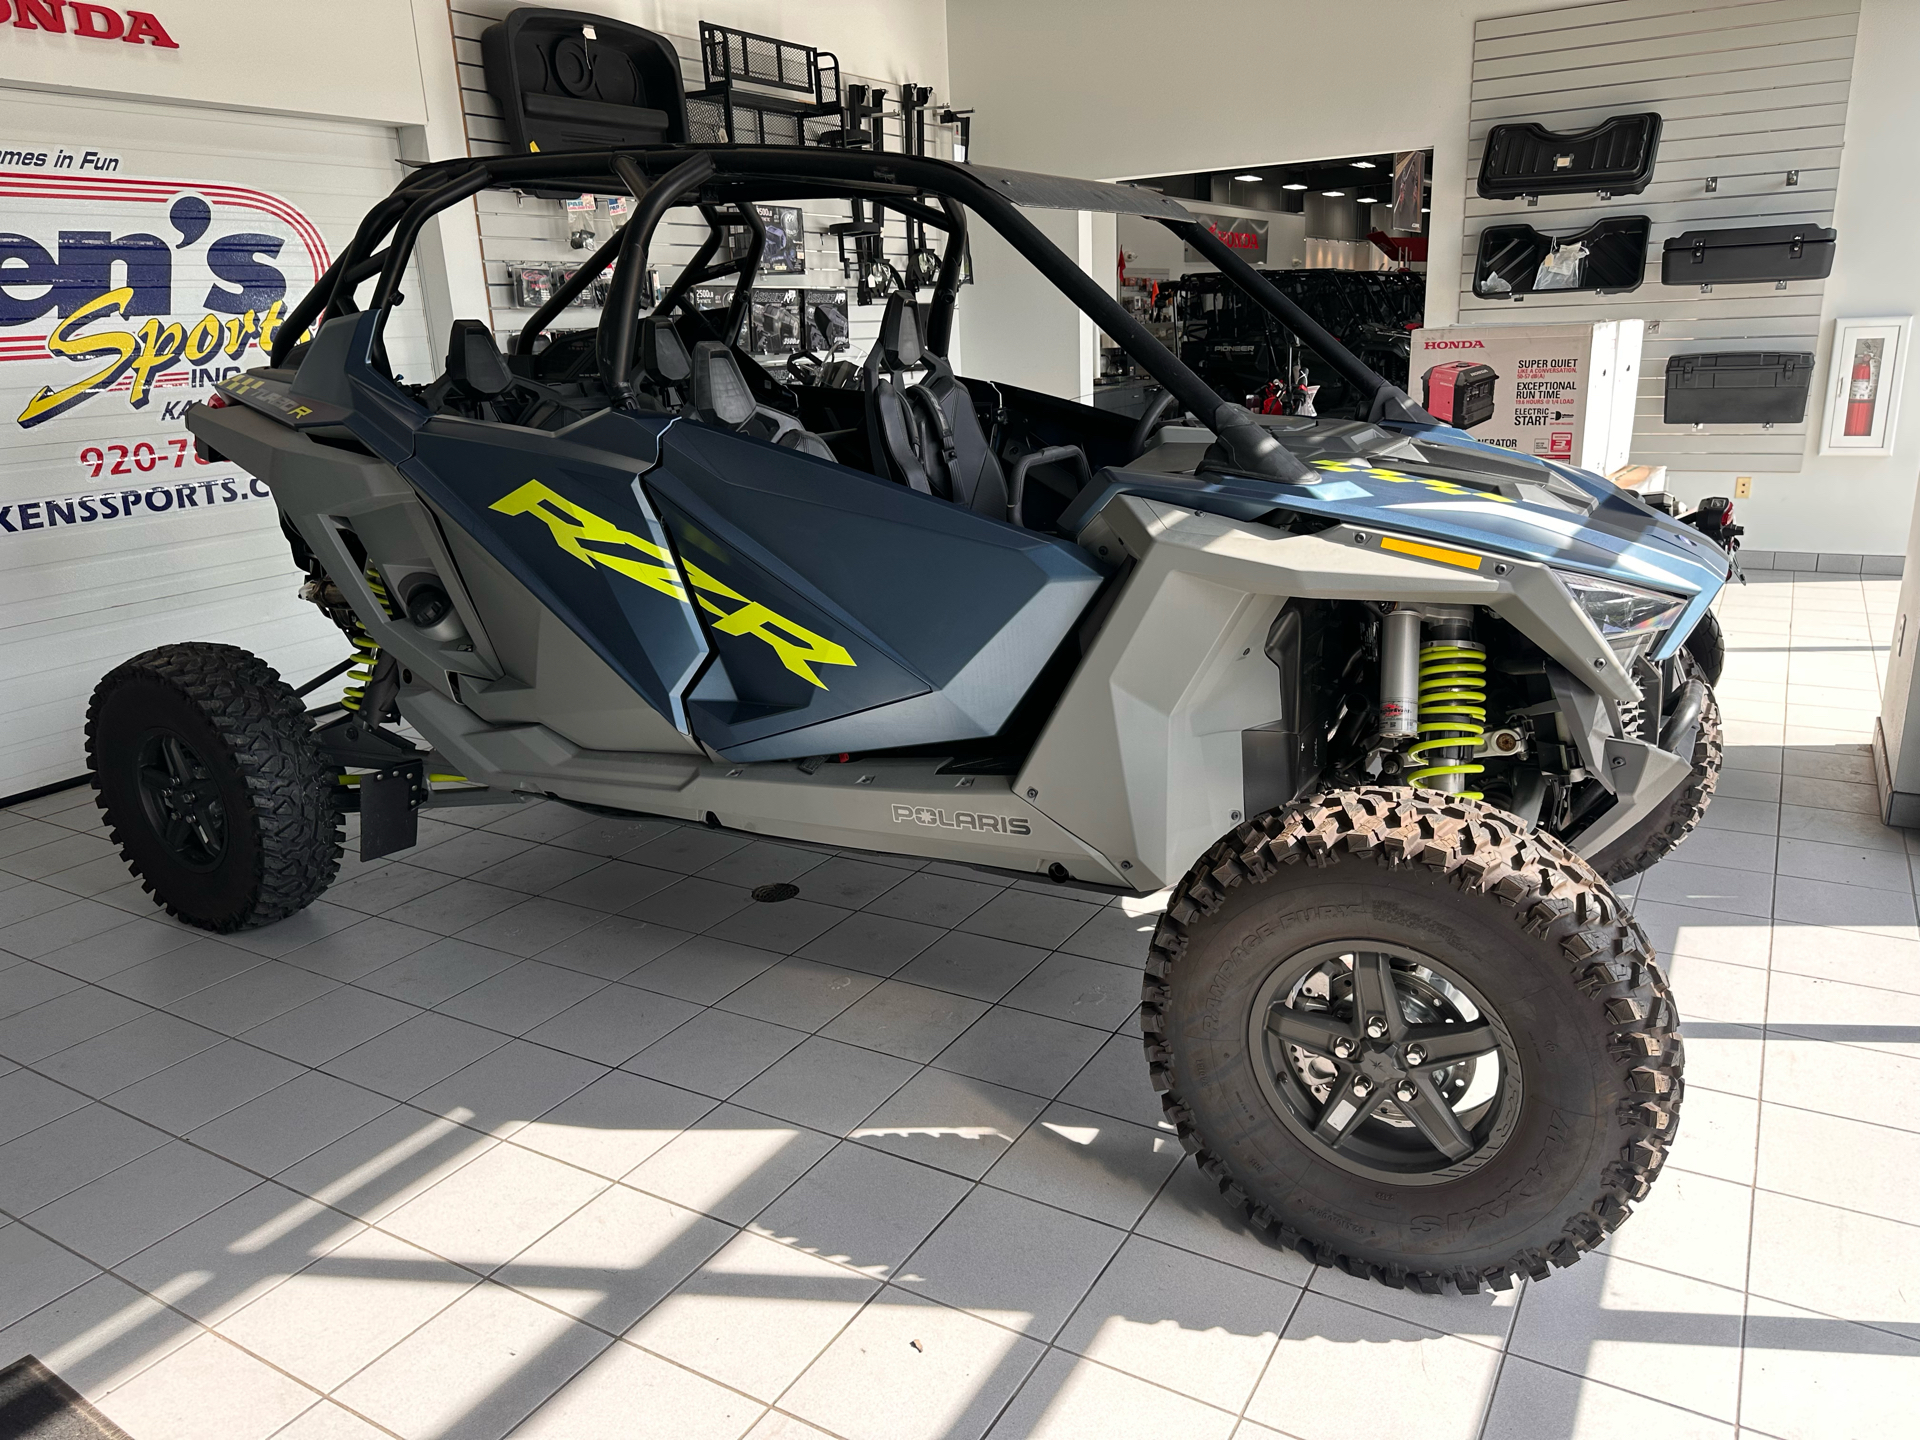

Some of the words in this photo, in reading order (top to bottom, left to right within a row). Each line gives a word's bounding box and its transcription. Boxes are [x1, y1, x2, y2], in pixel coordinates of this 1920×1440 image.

[0, 0, 180, 49] NDA
[0, 150, 48, 168] mes
[53, 149, 74, 170] in
[80, 151, 119, 172] Fun
[1217, 230, 1259, 250] HONDA
[17, 286, 312, 430] Sport
[1424, 340, 1485, 350] HONDA
[1518, 360, 1548, 368] SUPER
[1550, 358, 1578, 368] QUIET
[1516, 382, 1577, 390] EXCEPTIONAL
[1516, 390, 1536, 399] RUN
[1538, 390, 1560, 399] TIME
[250, 388, 300, 412] TURBO
[287, 406, 314, 420] R
[1514, 408, 1550, 416] ELECTRIC
[1514, 416, 1548, 426] START
[80, 438, 234, 478] 920-7
[0, 477, 270, 533] KENSSPORTS.C
[891, 803, 1033, 836] POLARIS
[1202, 922, 1275, 1033] RAMPAGE
[1279, 904, 1360, 931] FURY
[1410, 1109, 1570, 1235] MAXXIS
